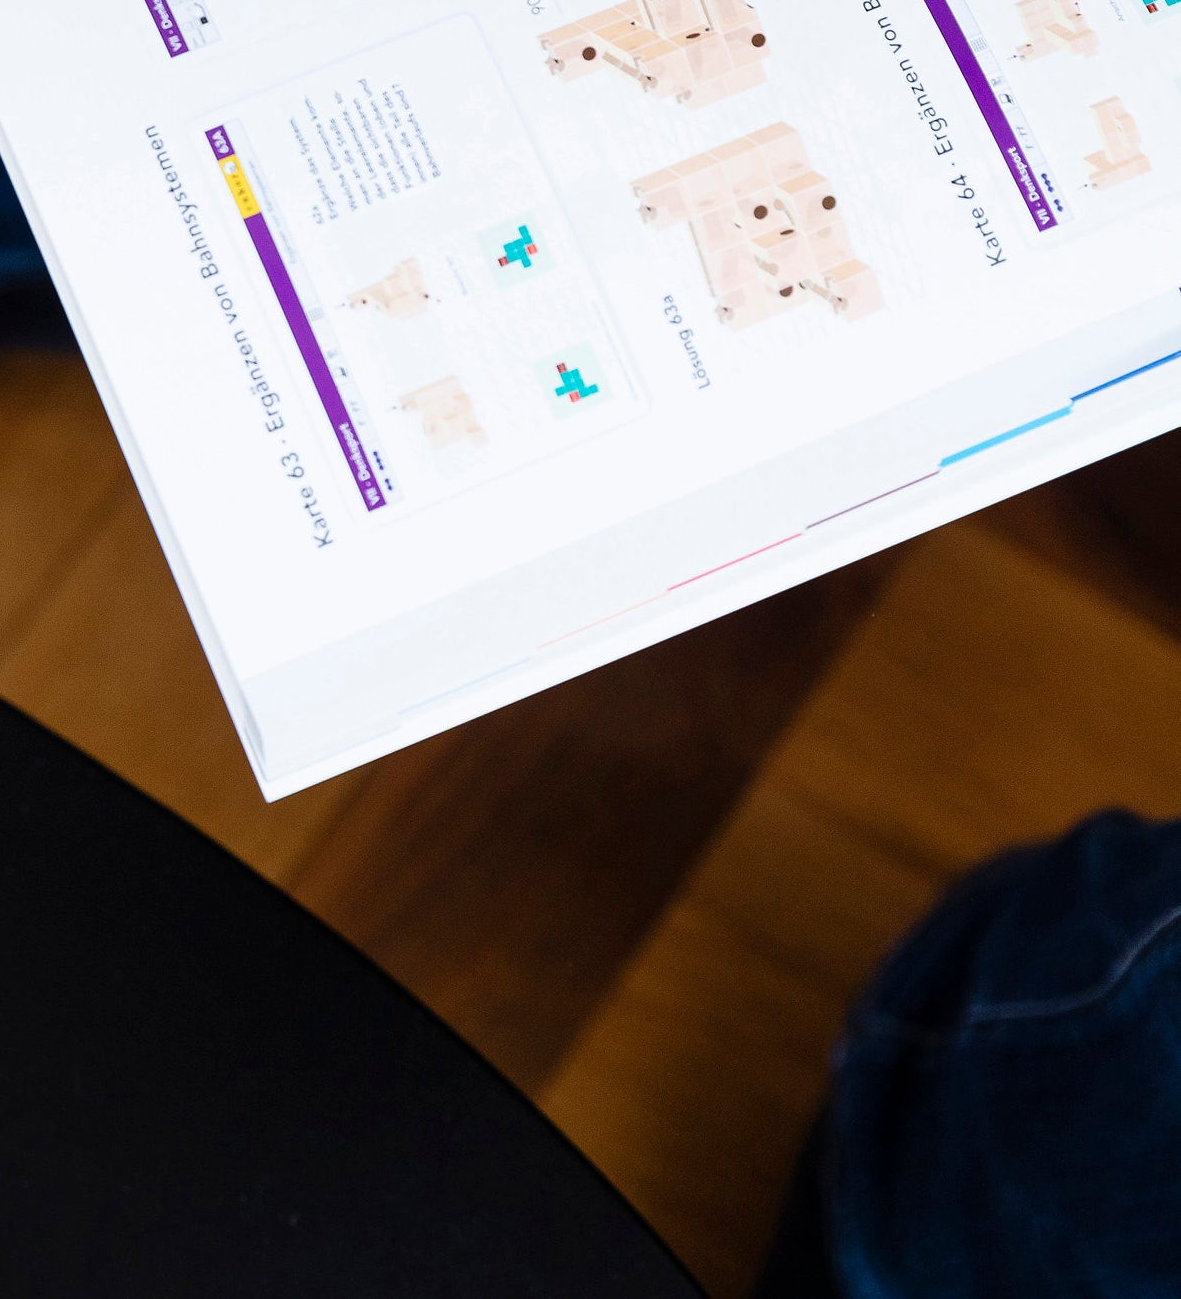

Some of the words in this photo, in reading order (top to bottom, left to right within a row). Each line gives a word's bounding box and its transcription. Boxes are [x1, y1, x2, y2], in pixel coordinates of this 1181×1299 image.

[167, 34, 183, 52] VII
[877, 16, 903, 54] von
[899, 58, 954, 156] Ergänzen
[950, 174, 975, 200] 64
[1007, 145, 1041, 203] Denksport
[145, 125, 220, 280] Bahnsystemen
[1035, 208, 1051, 226] VII
[971, 206, 1007, 267] Karte
[213, 283, 238, 325] von
[663, 294, 683, 325] 63a
[233, 329, 285, 433] Ergänzen
[678, 328, 711, 390] Lösung
[280, 452, 305, 479] 63
[300, 486, 334, 549] Karte
